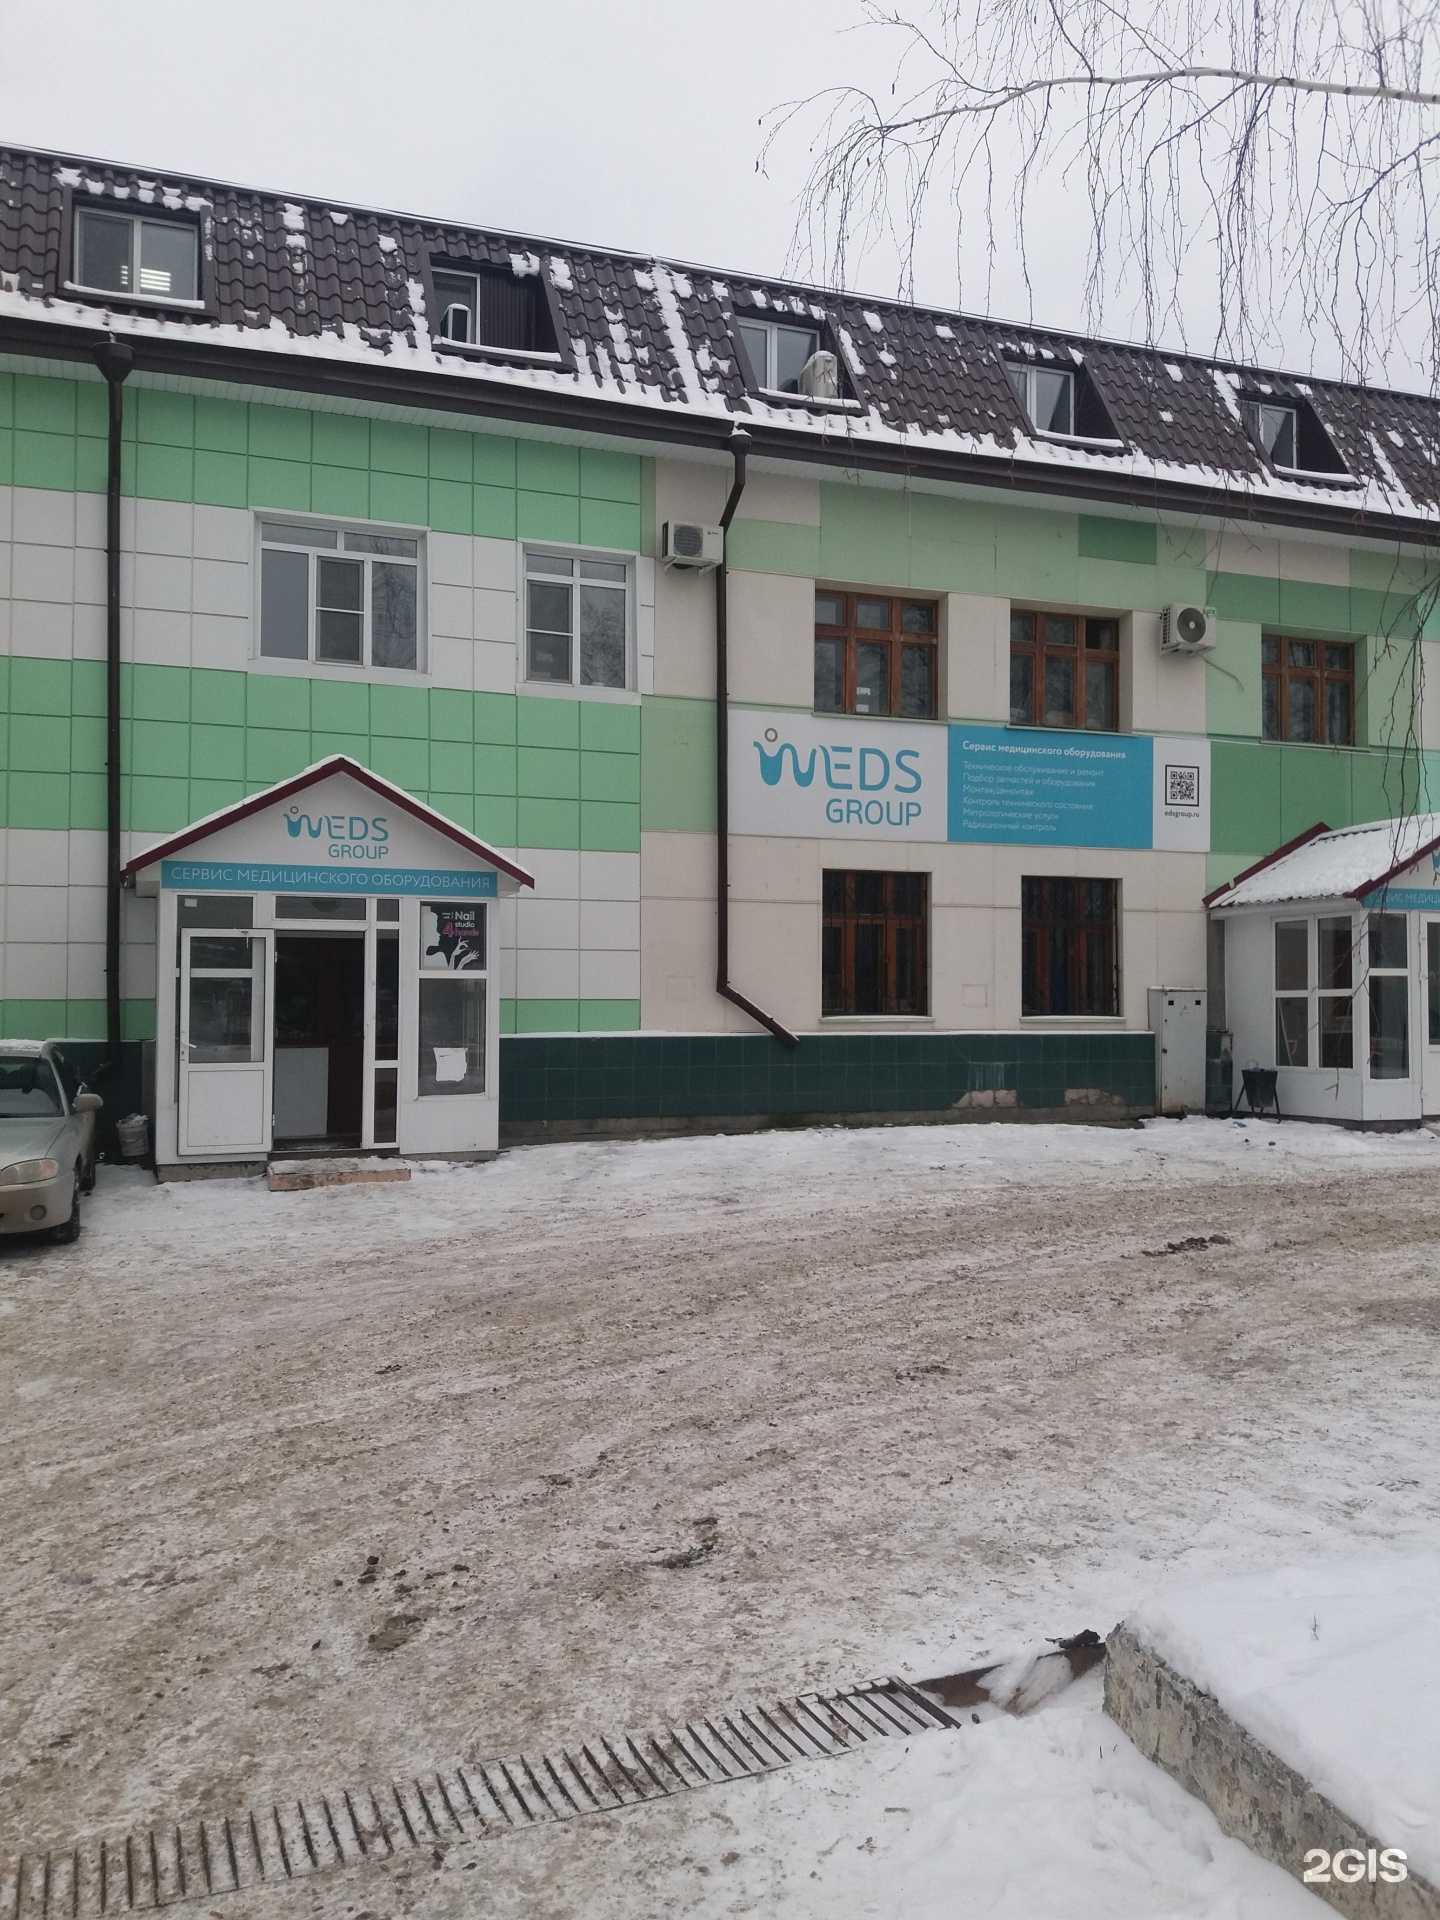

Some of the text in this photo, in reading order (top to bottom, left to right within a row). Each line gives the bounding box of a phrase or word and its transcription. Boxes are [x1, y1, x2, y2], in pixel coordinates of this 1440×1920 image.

[962, 740, 1126, 760] Сервис медицинского оборудования
[826, 799, 922, 826] GROUP
[328, 843, 389, 860] GROUP
[171, 866, 490, 889] СЕРВИС МЕДИЦИНСКОГО ОБОРУДОВАНИЯ
[454, 911, 475, 921] Nail
